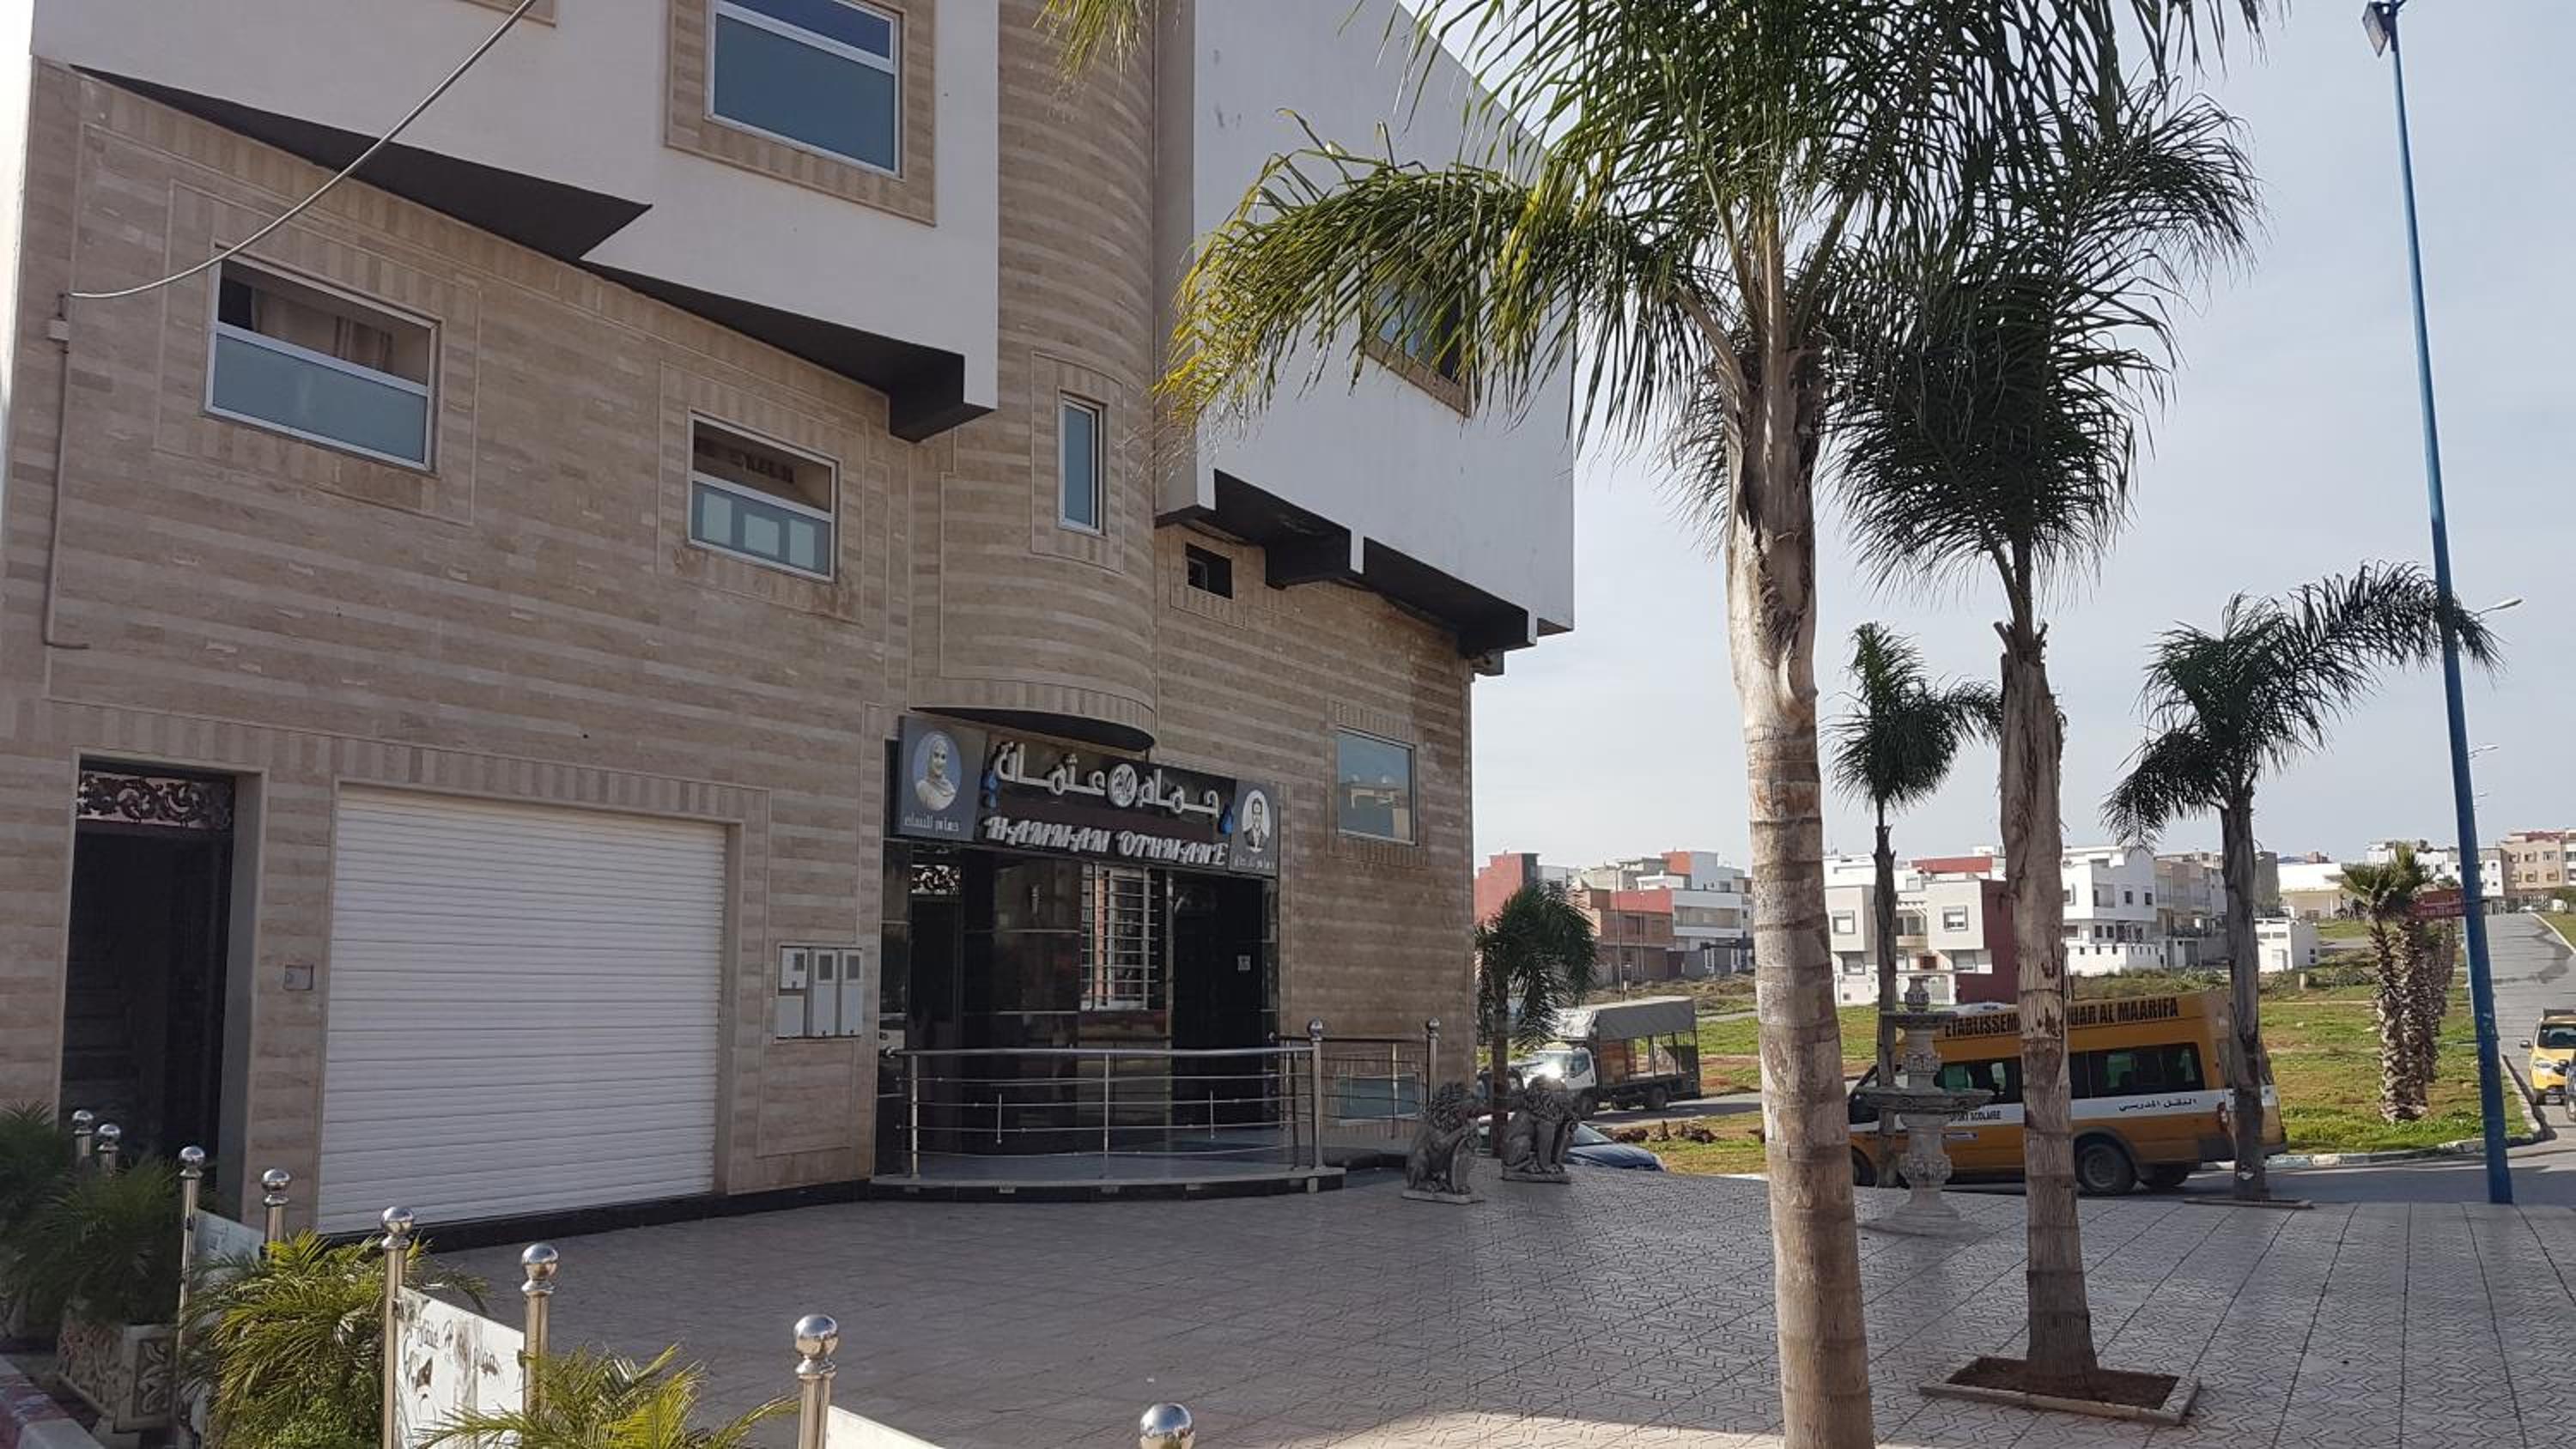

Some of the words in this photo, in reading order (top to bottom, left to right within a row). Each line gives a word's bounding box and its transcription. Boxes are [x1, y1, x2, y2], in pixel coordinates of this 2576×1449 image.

[1135, 768, 1219, 817] حمام
[1117, 830, 1229, 865] OTHMANE
[1945, 1014, 2020, 1038] ETABLISSEM
[2099, 1003, 2114, 1024] AL
[2117, 997, 2179, 1022] MAARIFA
